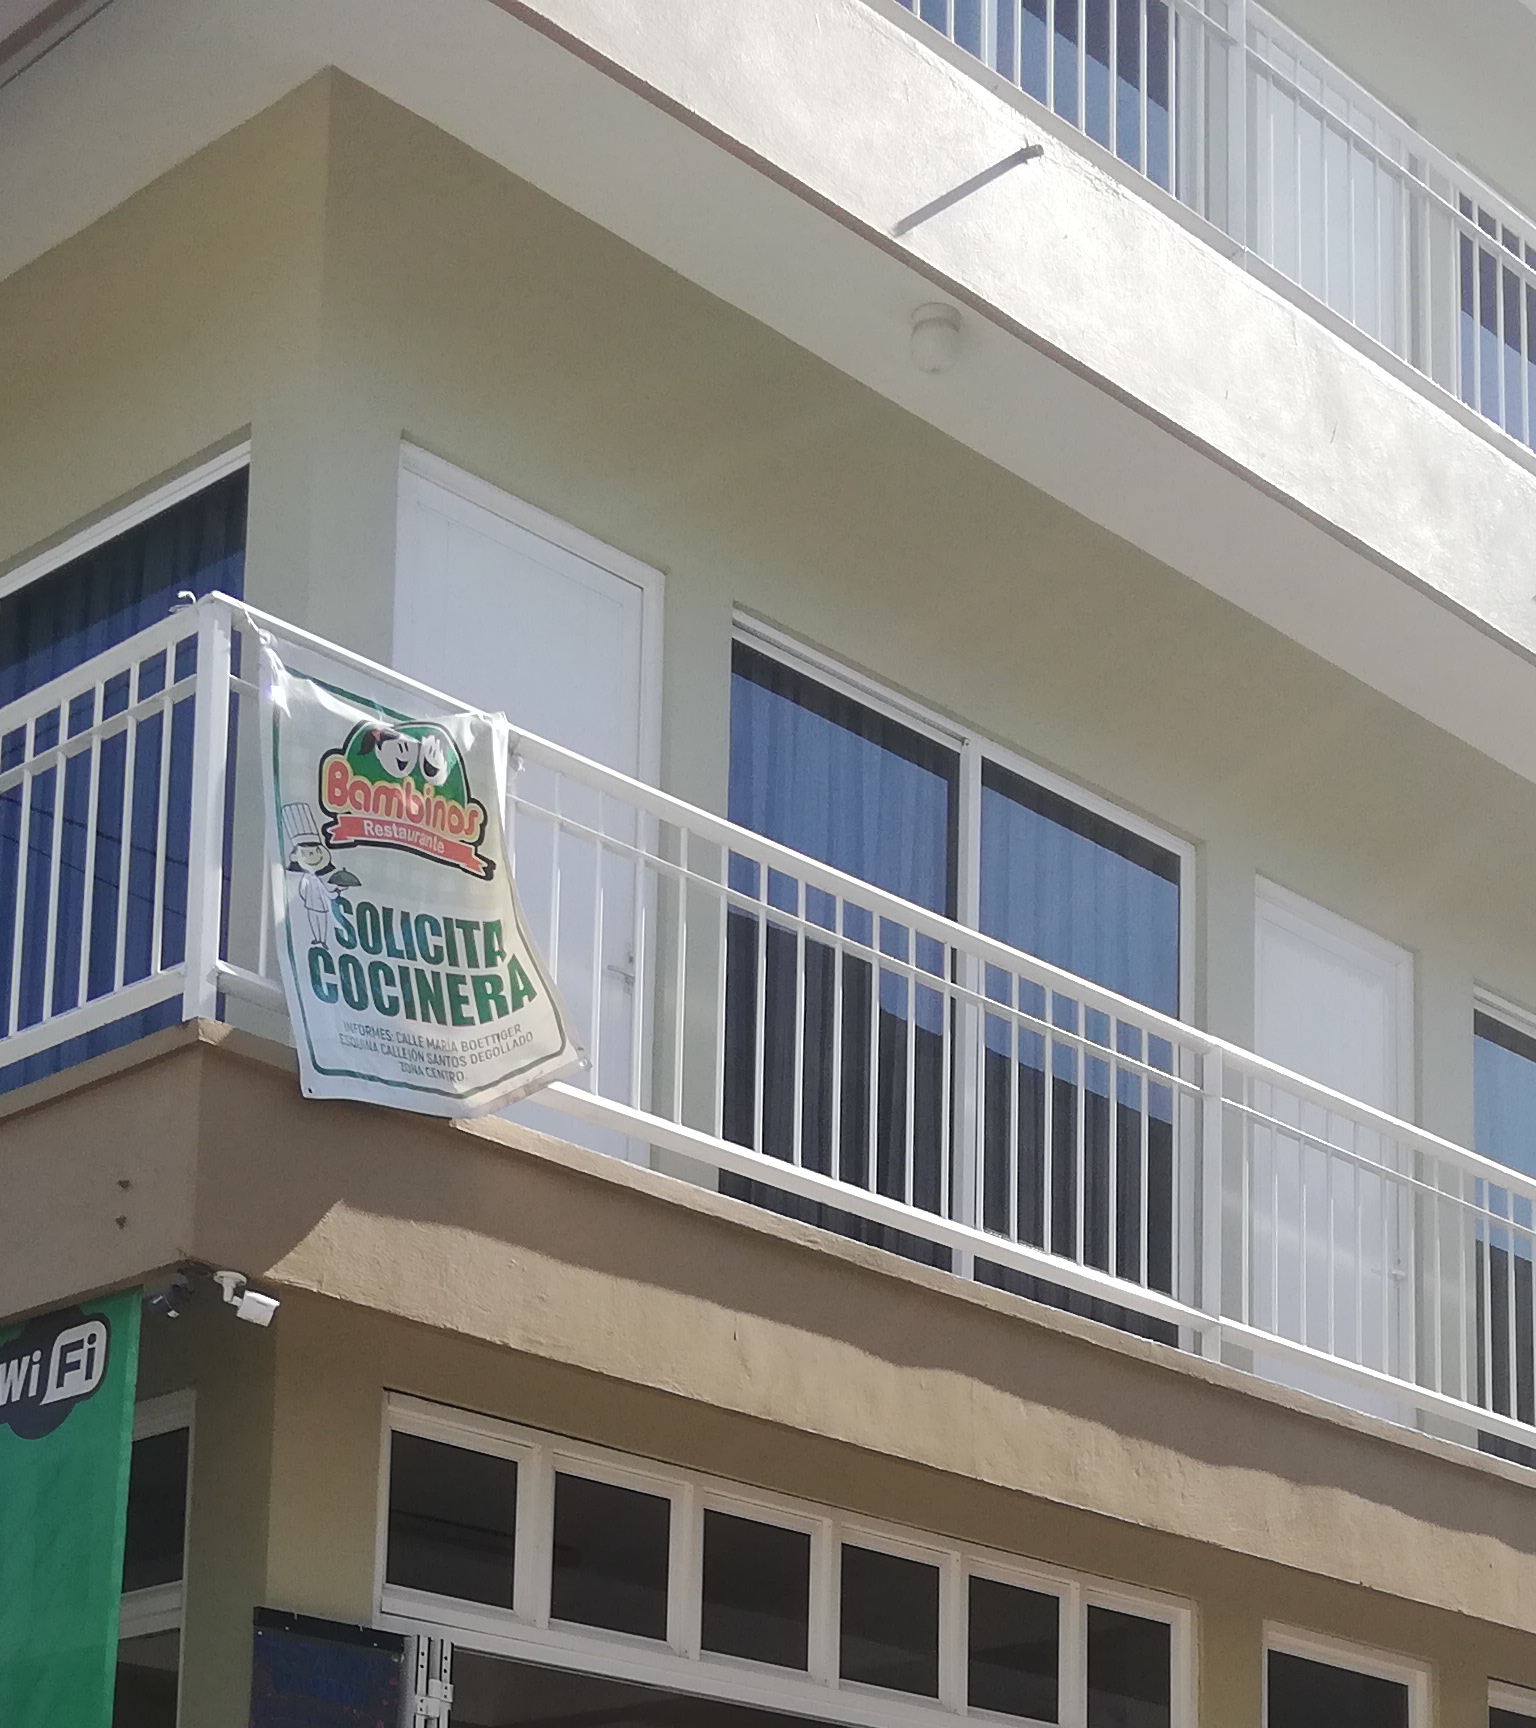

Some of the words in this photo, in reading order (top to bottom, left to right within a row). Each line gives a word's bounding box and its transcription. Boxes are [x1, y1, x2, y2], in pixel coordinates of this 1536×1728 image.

[327, 760, 479, 836] Bambinos
[363, 819, 446, 854] Restaurante
[330, 898, 508, 969] SOLICITA
[307, 946, 538, 1027] COCINERA
[339, 1032, 380, 1052] ESQUINA
[426, 1051, 468, 1069] SANTOS
[470, 1030, 534, 1065] DEGOLLADO
[343, 1021, 395, 1043] INFORMES:
[396, 1032, 424, 1049] CALLE
[461, 1023, 523, 1053] BOETTIGER
[399, 1061, 424, 1076] ZONA
